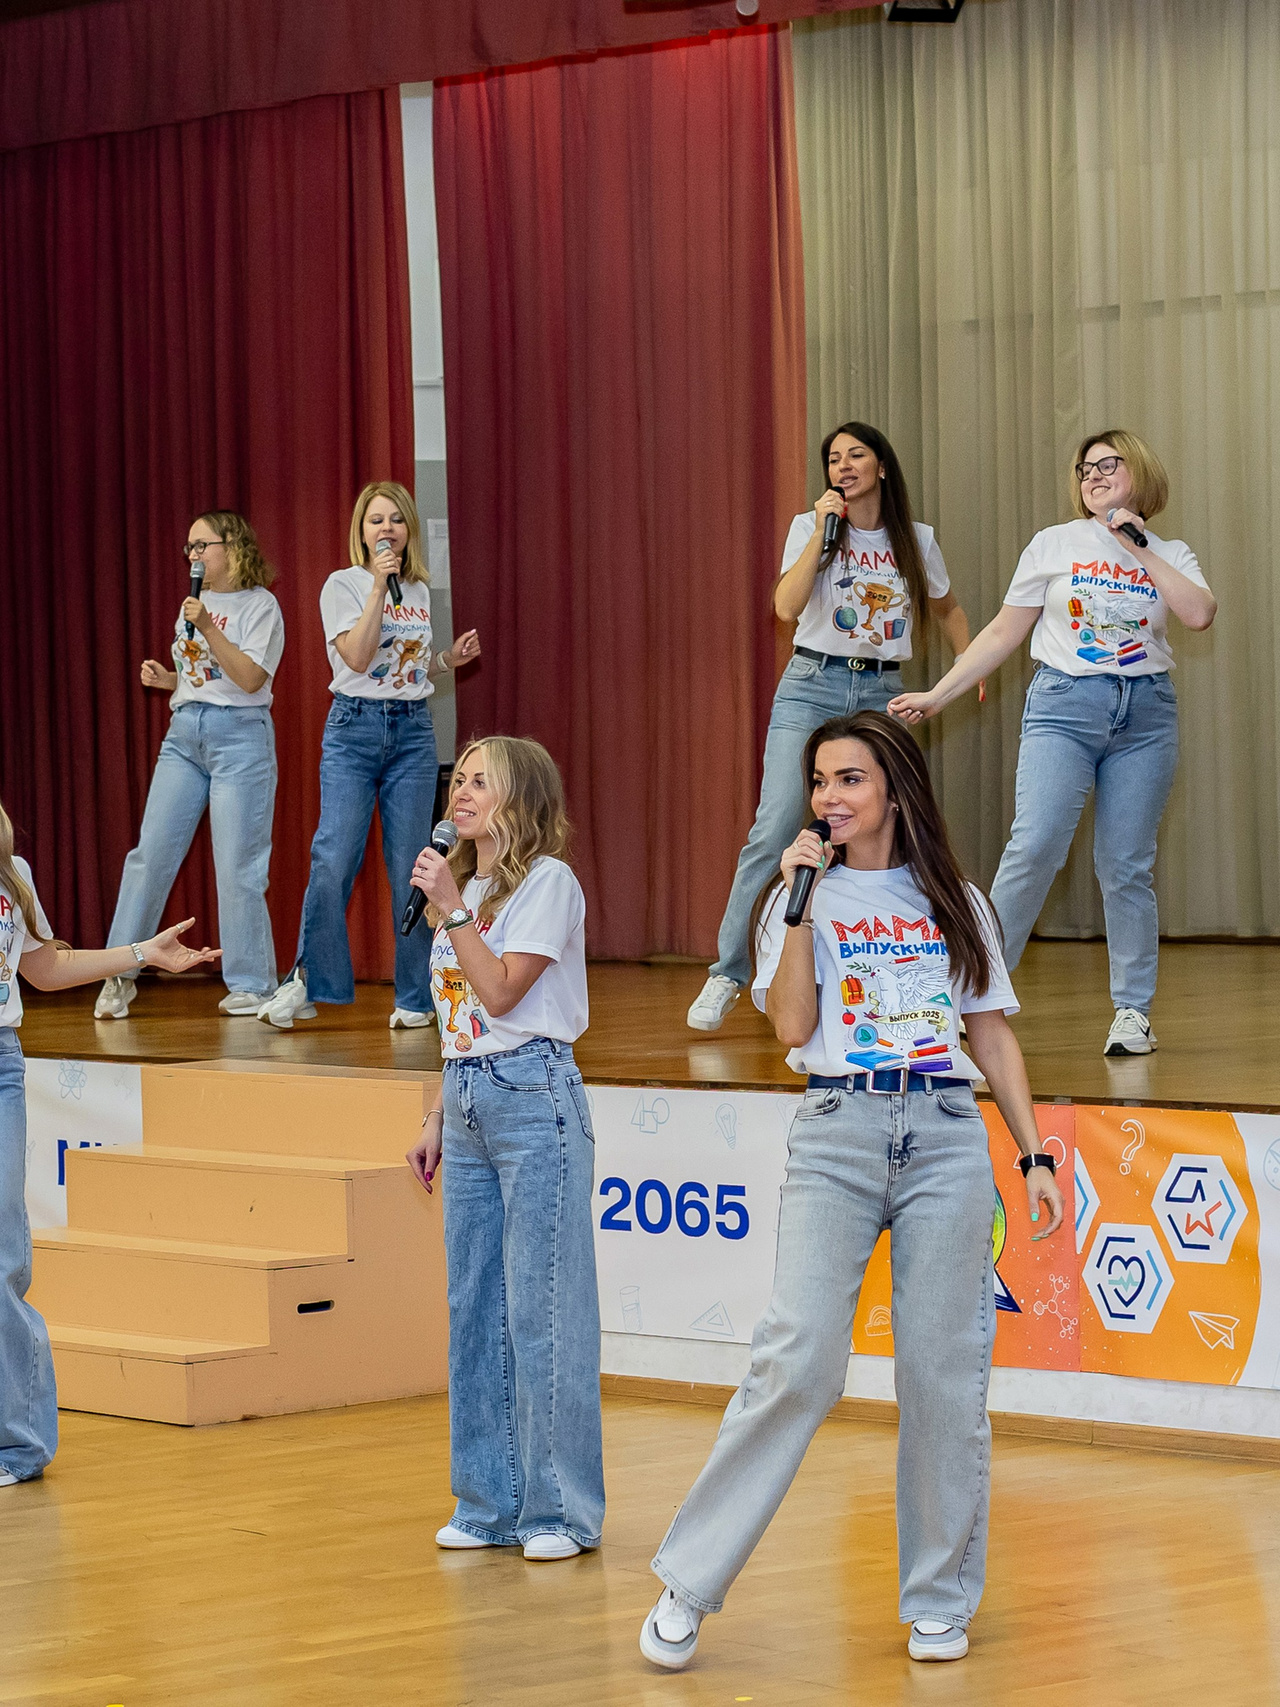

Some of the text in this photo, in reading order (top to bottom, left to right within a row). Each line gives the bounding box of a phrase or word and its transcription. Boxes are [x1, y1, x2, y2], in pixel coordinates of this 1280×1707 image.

[839, 549, 898, 570] МАМ
[1071, 560, 1157, 587] МАМА
[1071, 575, 1159, 600] ВЫПУСКНИКА
[839, 941, 951, 960] ВЫПУСКНИК
[889, 1009, 940, 1023] ВЫПУСК 2025
[599, 1176, 750, 1241] 2065
